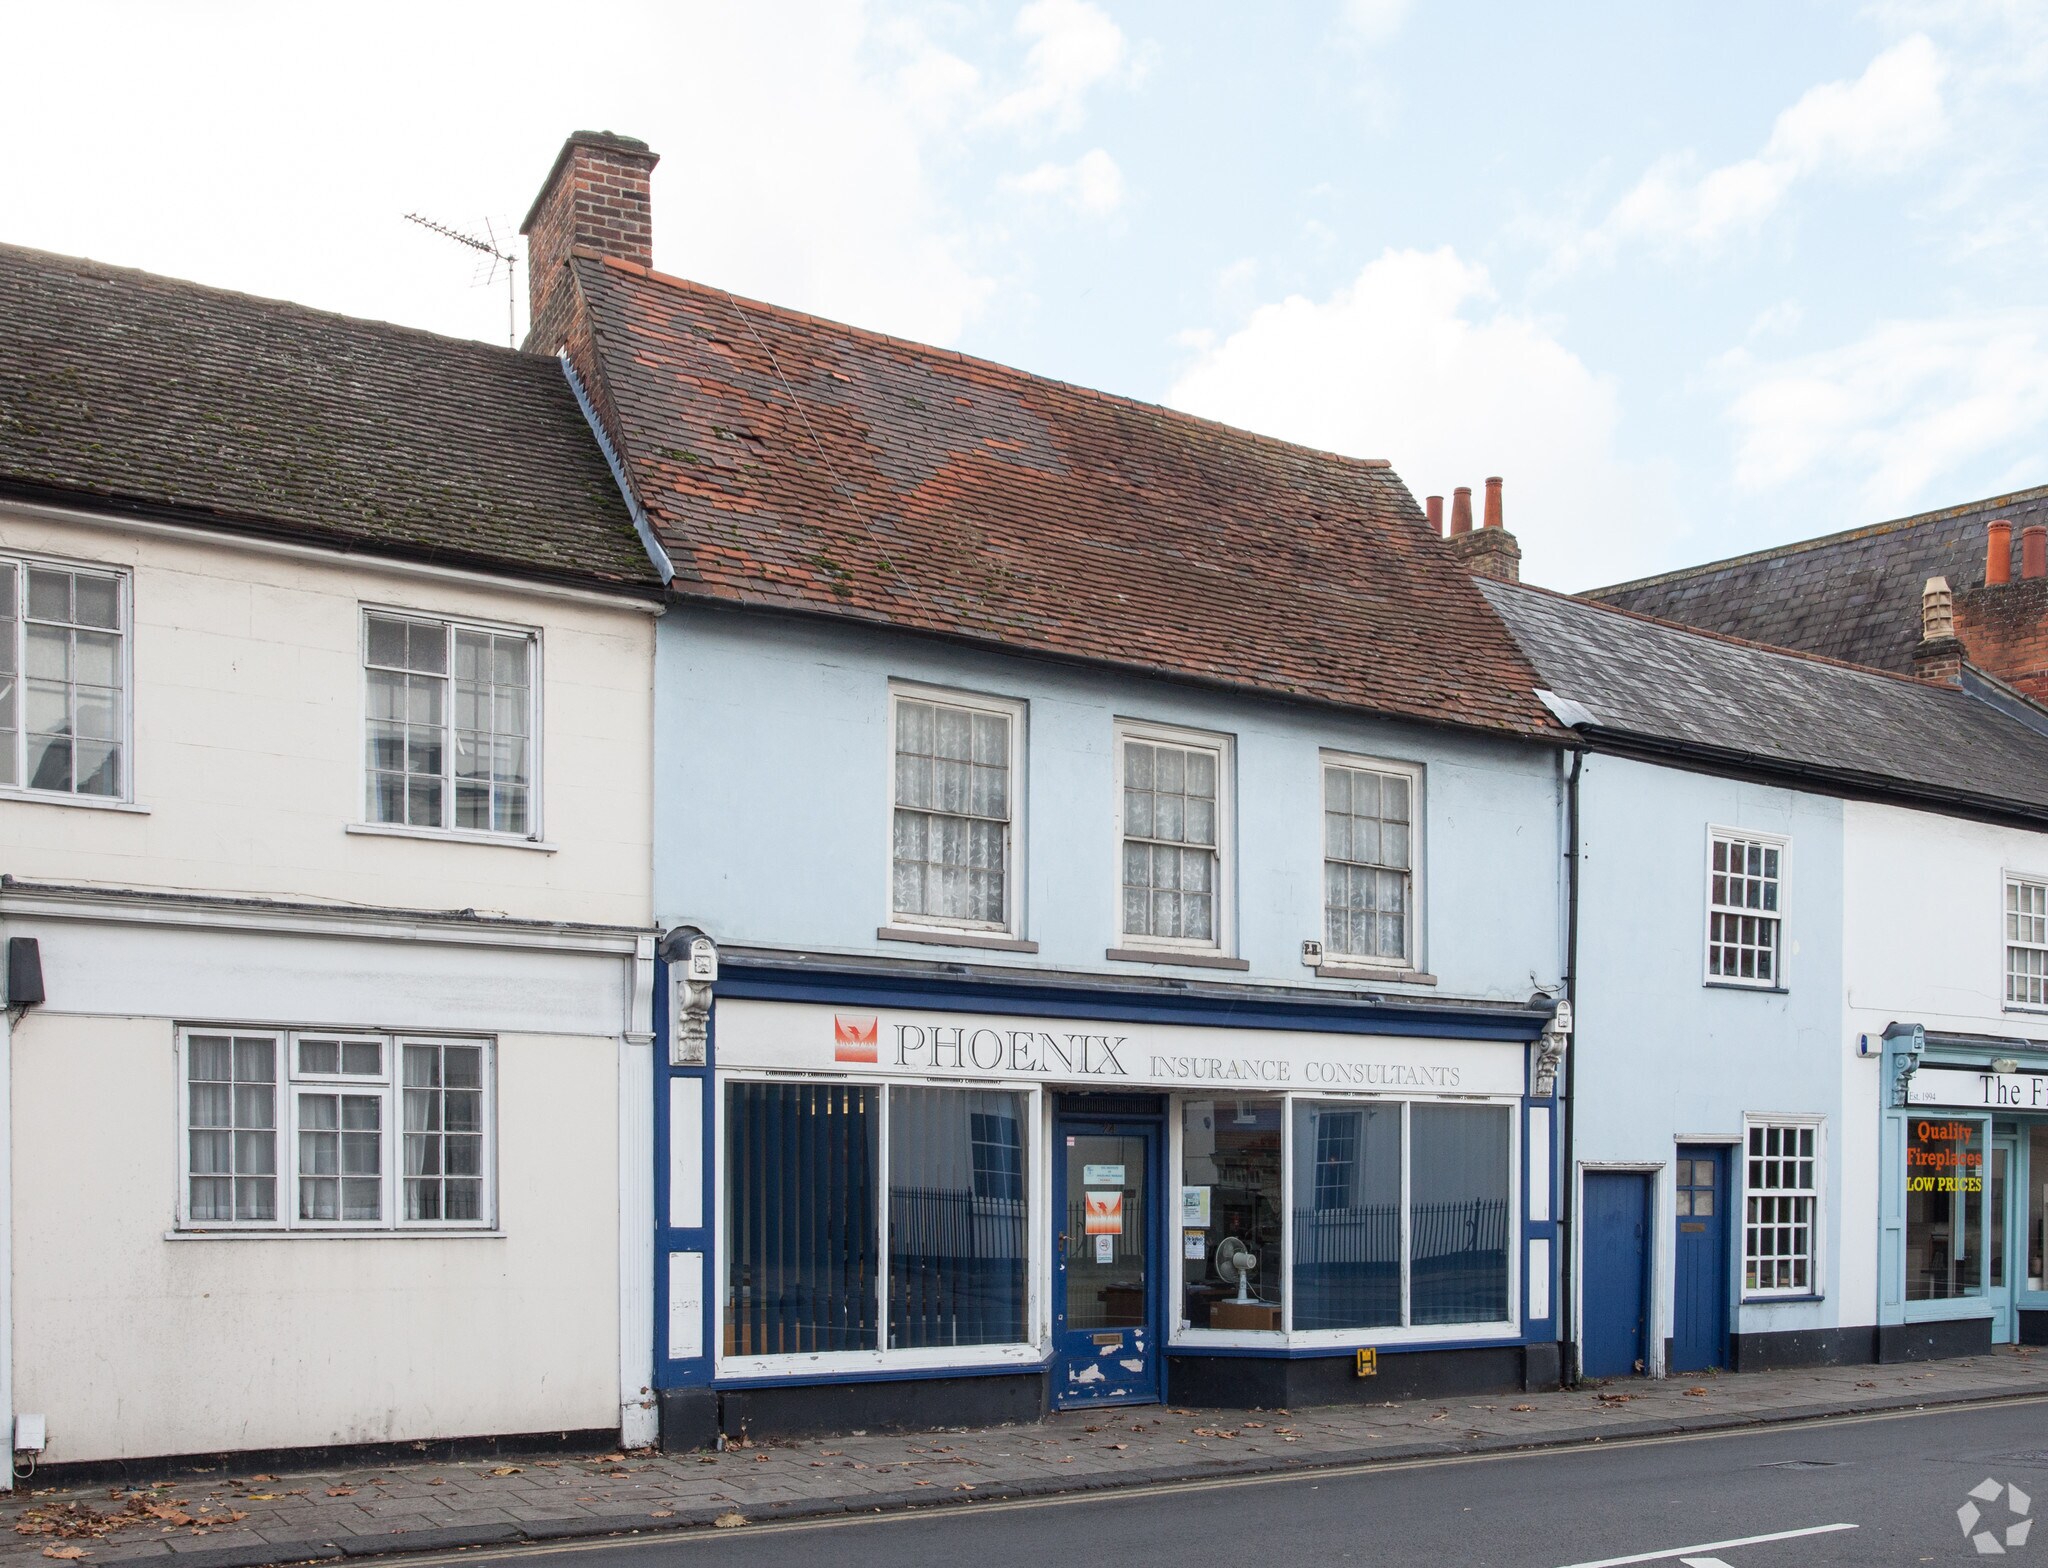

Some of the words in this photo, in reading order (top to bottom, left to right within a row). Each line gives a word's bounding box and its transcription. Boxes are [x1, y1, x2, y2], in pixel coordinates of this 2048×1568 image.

[893, 1024, 1129, 1075] PHOENIX
[1149, 1056, 1291, 1082] INSURANCE
[1304, 1062, 1460, 1087] CONSULTANTS
[1922, 1092, 1936, 1102] 1994
[1979, 1074, 2021, 1105] The
[2030, 1078, 2048, 1106] F
[1917, 1121, 1973, 1145] Quality
[1907, 1147, 1983, 1171] Fireplaces
[1907, 1177, 1935, 1192] LOW
[1937, 1177, 1982, 1192] PRICES
